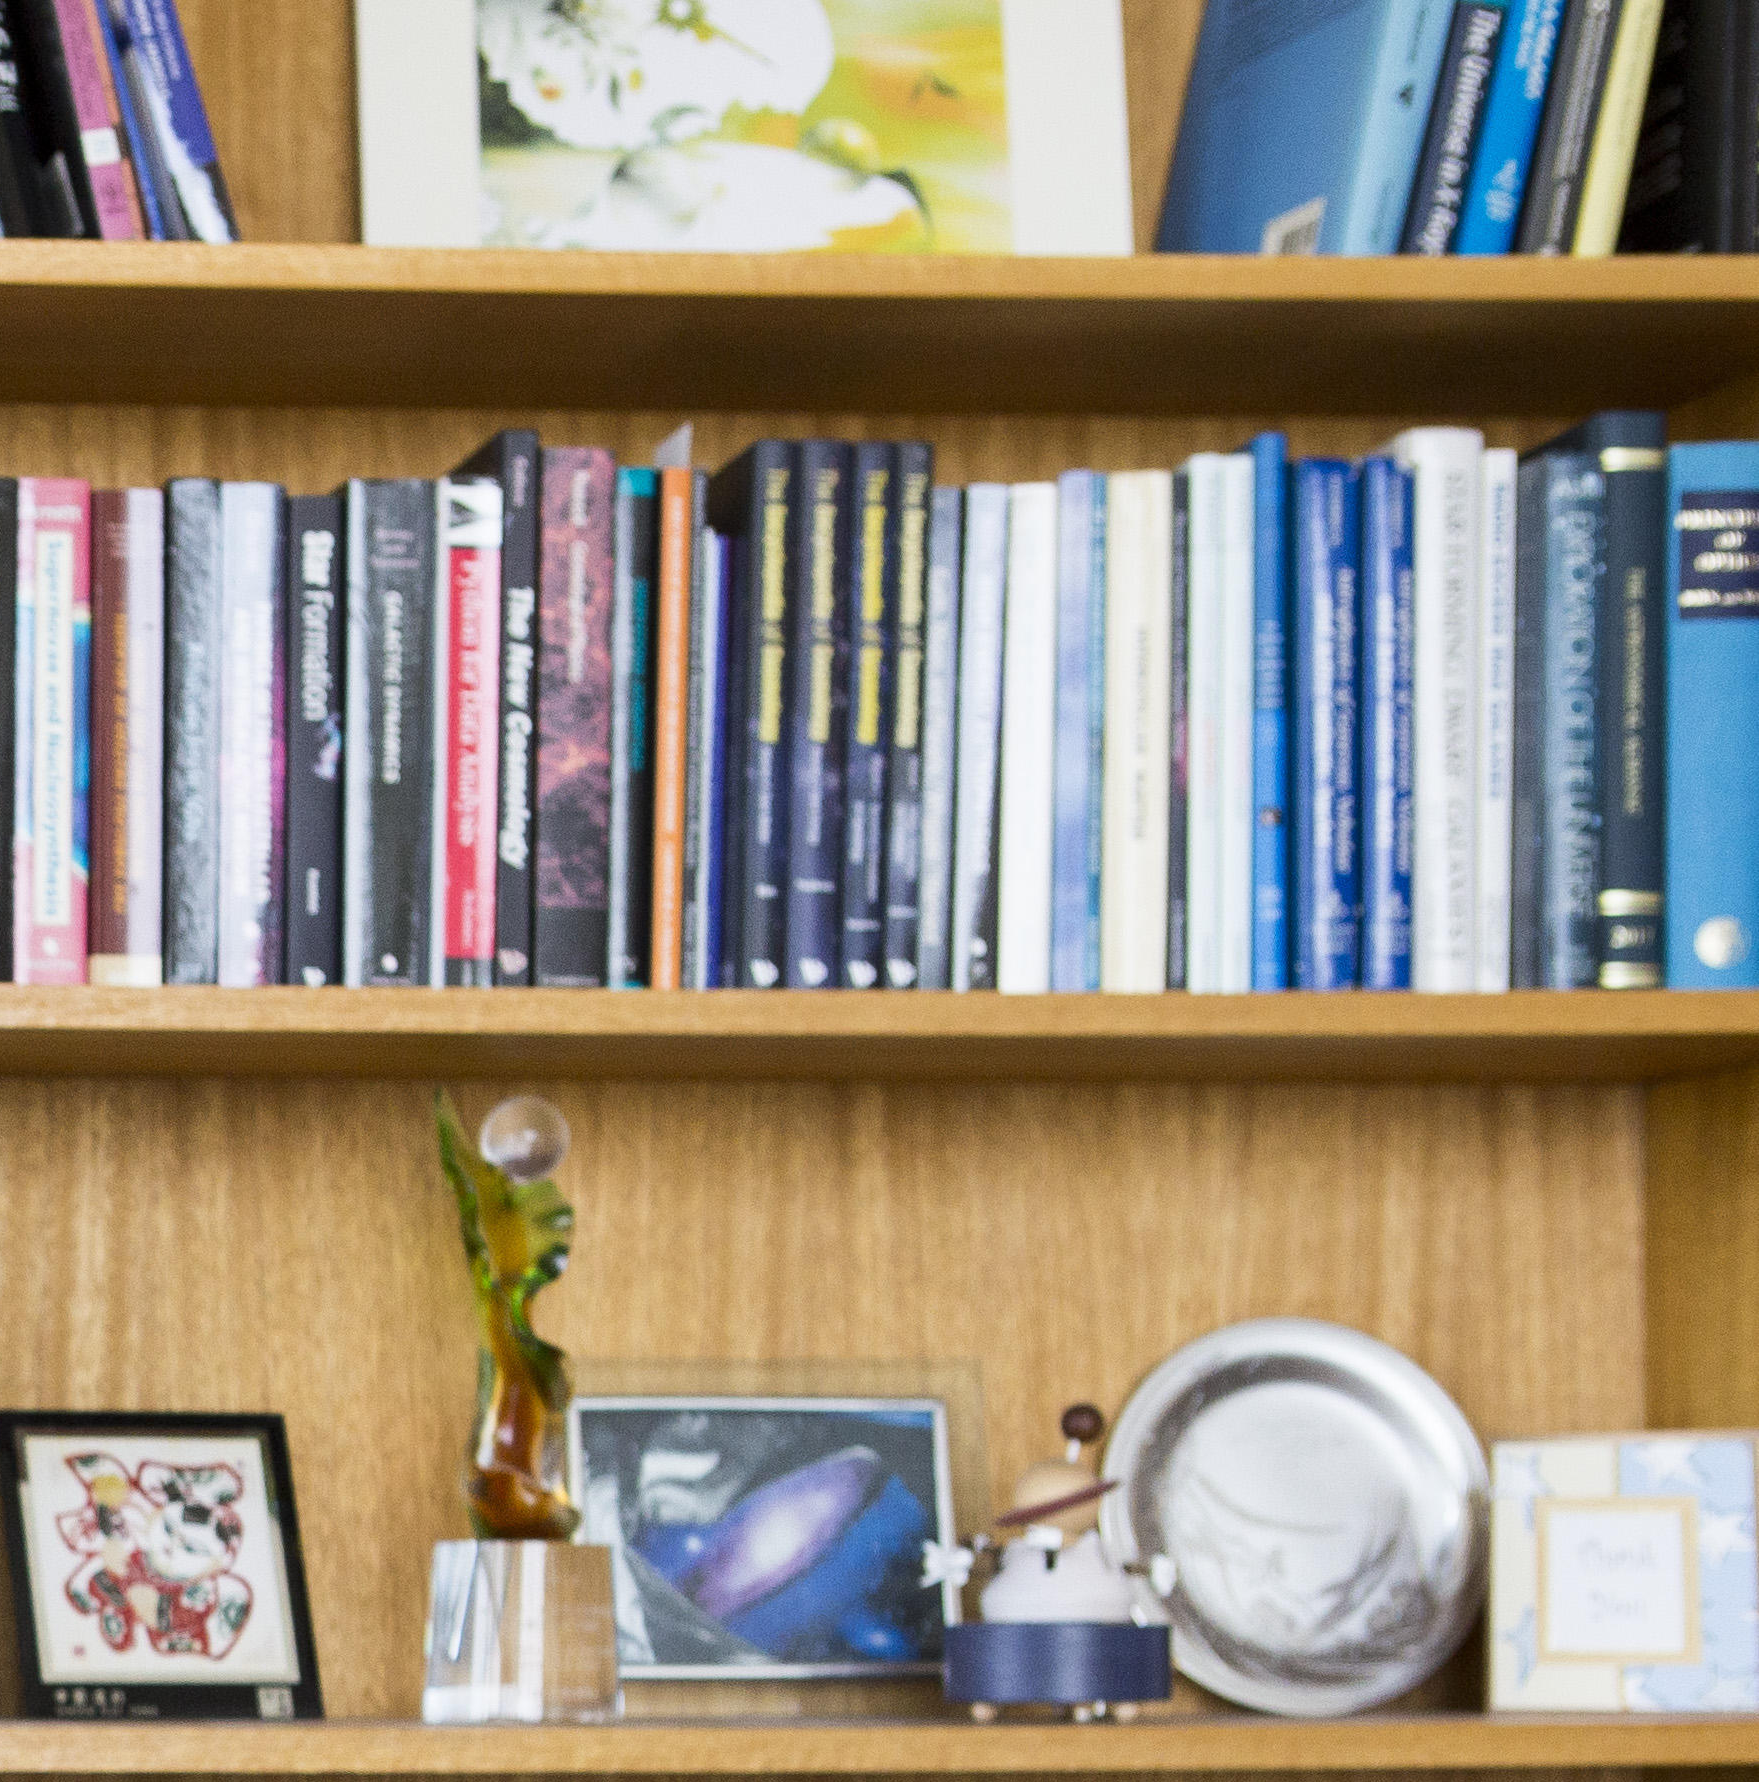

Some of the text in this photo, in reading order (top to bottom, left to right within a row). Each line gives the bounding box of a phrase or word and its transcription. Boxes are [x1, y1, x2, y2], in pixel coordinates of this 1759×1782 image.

[1438, 51, 1494, 158] Universe
[1461, 5, 1503, 57] The
[301, 530, 336, 723] Star Formation
[381, 589, 403, 785] GALACTIC DYNAMICS
[42, 541, 64, 917] Supernovae and Nucleosynthesis
[498, 586, 535, 871] The New Cosmology
